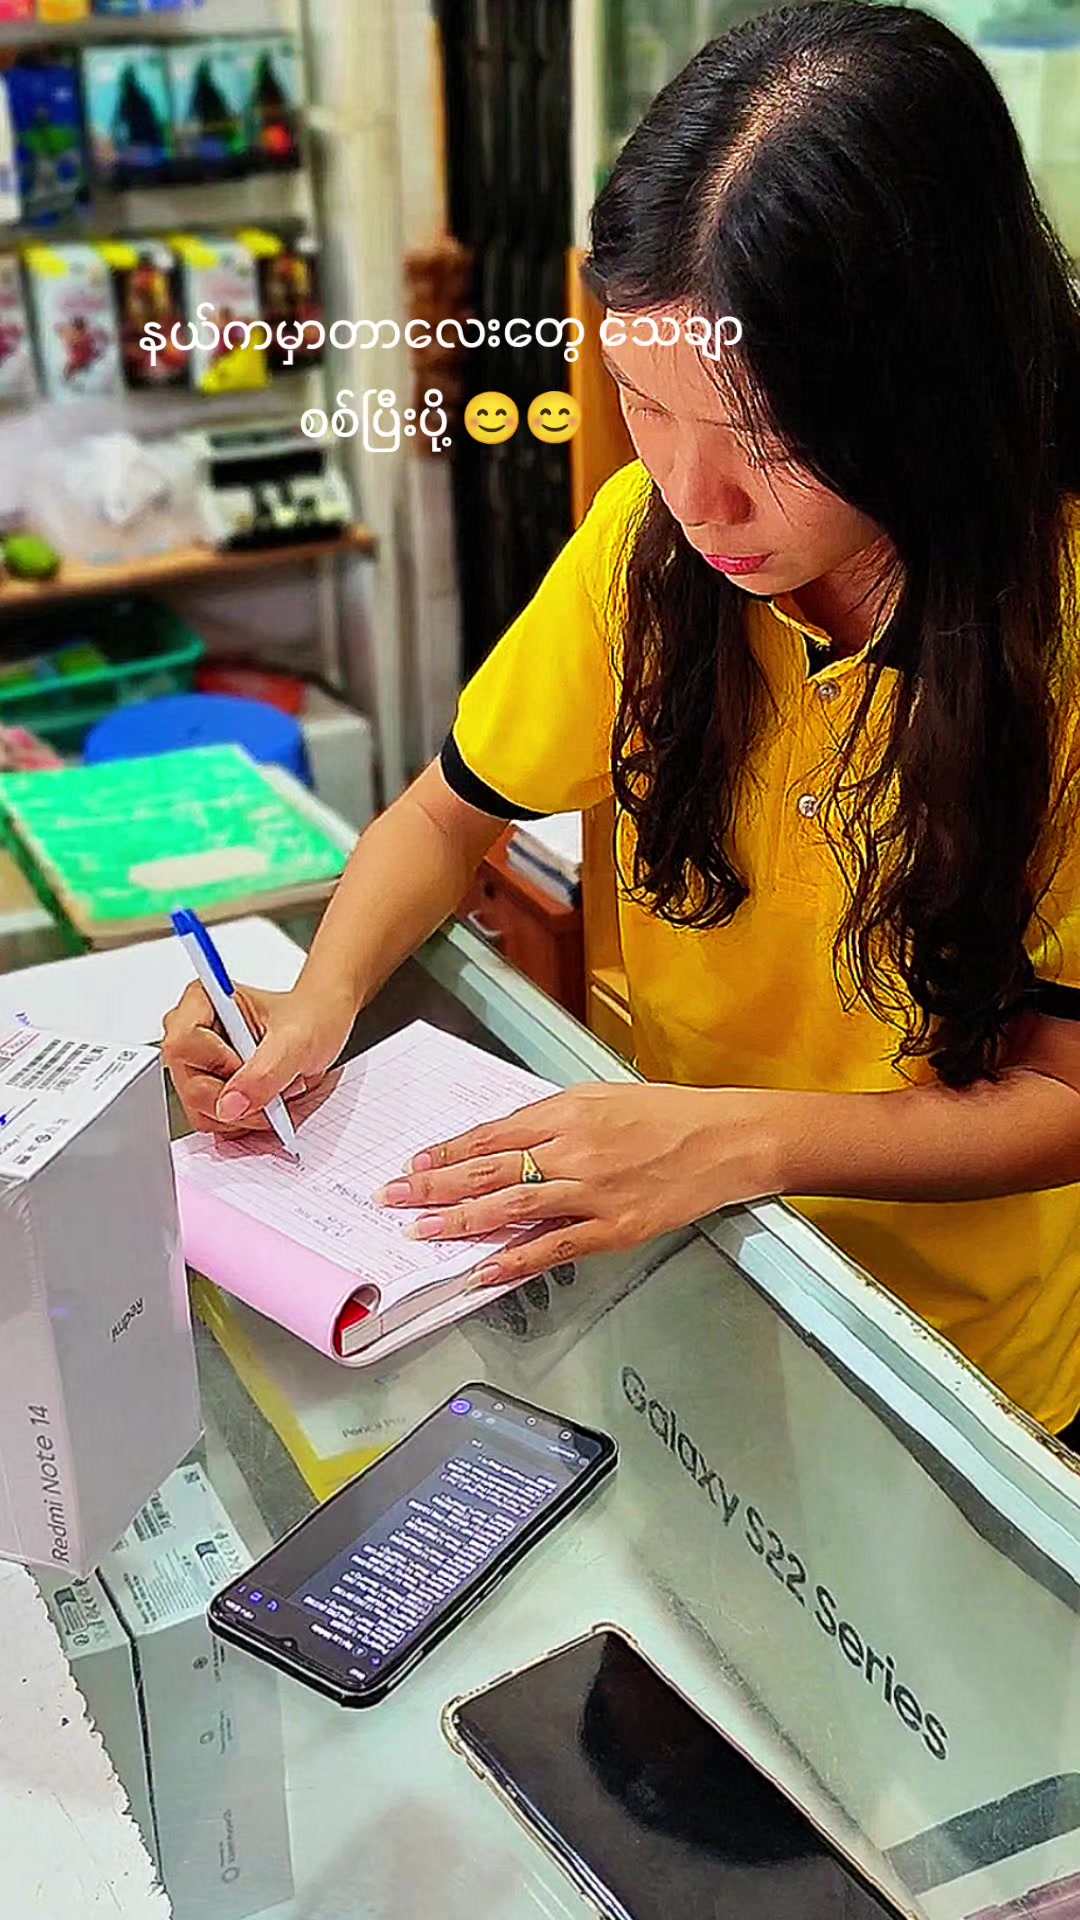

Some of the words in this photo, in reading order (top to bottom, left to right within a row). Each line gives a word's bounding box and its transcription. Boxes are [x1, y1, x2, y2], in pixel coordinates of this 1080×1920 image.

[112, 1297, 144, 1343] Redmi
[28, 1404, 51, 1426] 14
[36, 1435, 62, 1495] Note
[43, 1499, 70, 1564] Redmi
[622, 1366, 739, 1526] Galaxy
[746, 1506, 806, 1607] S22
[815, 1585, 948, 1760] Series
